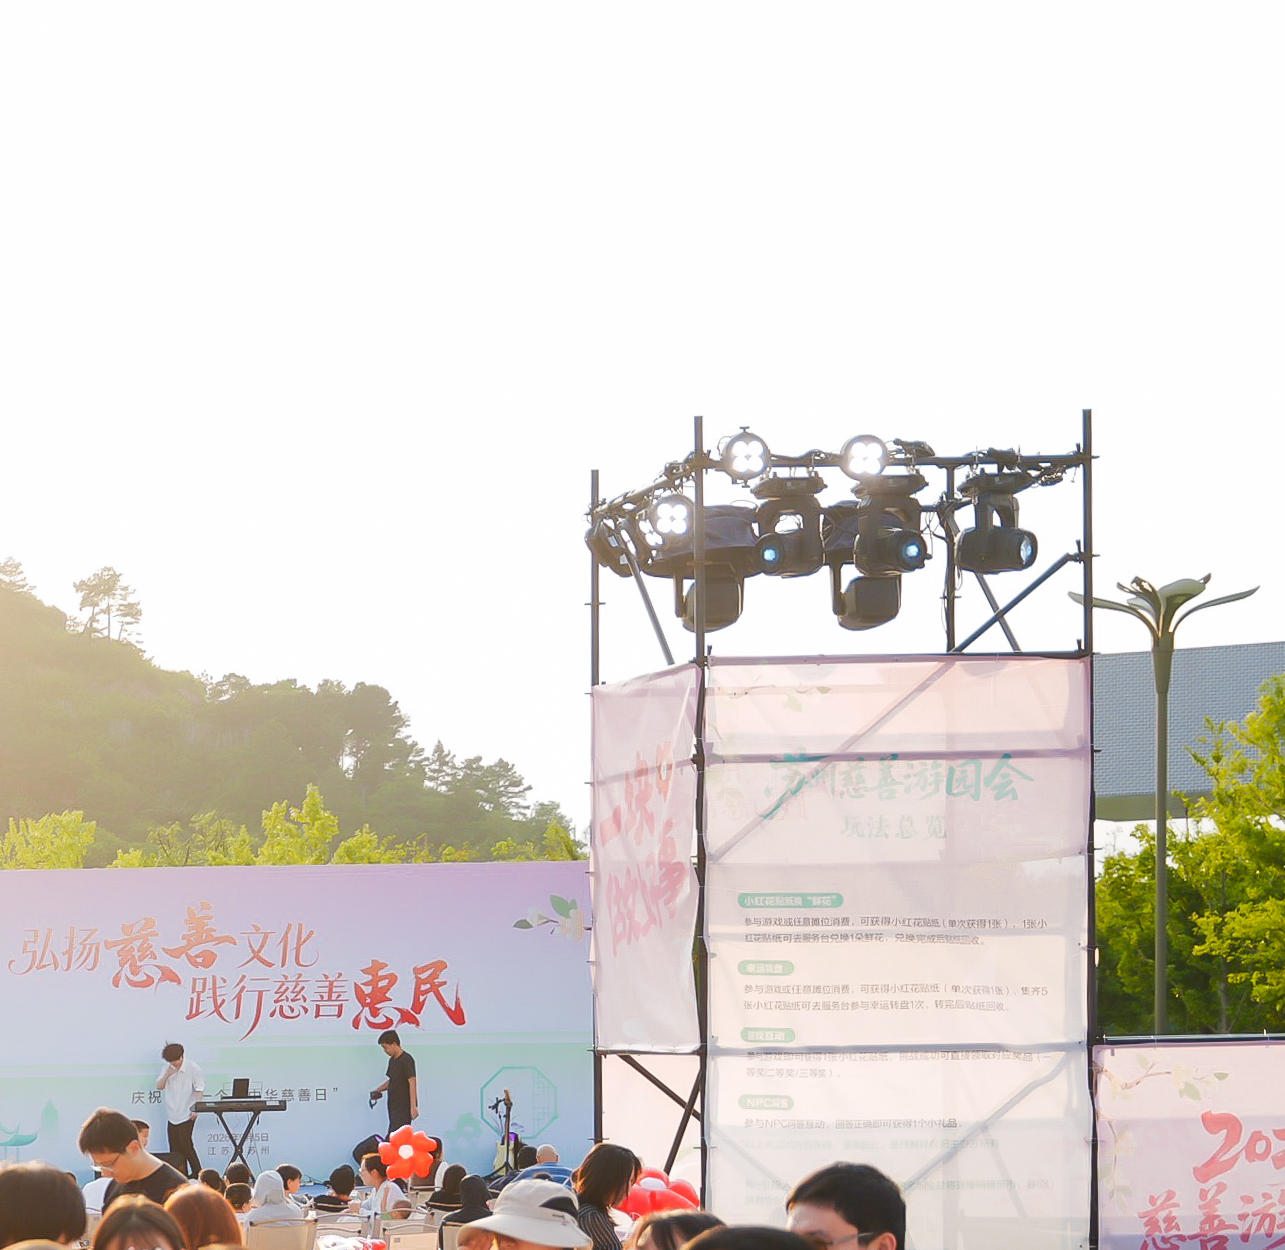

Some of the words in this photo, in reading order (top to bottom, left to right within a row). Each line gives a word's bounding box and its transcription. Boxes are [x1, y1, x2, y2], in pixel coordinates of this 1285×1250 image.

[839, 813, 948, 841] 玩法总览
[8, 902, 319, 989] 弘扬慈善文化
[186, 958, 467, 1042] 践行慈善惠民
[130, 1086, 338, 1104] 庆祝一个中华慈善日”
